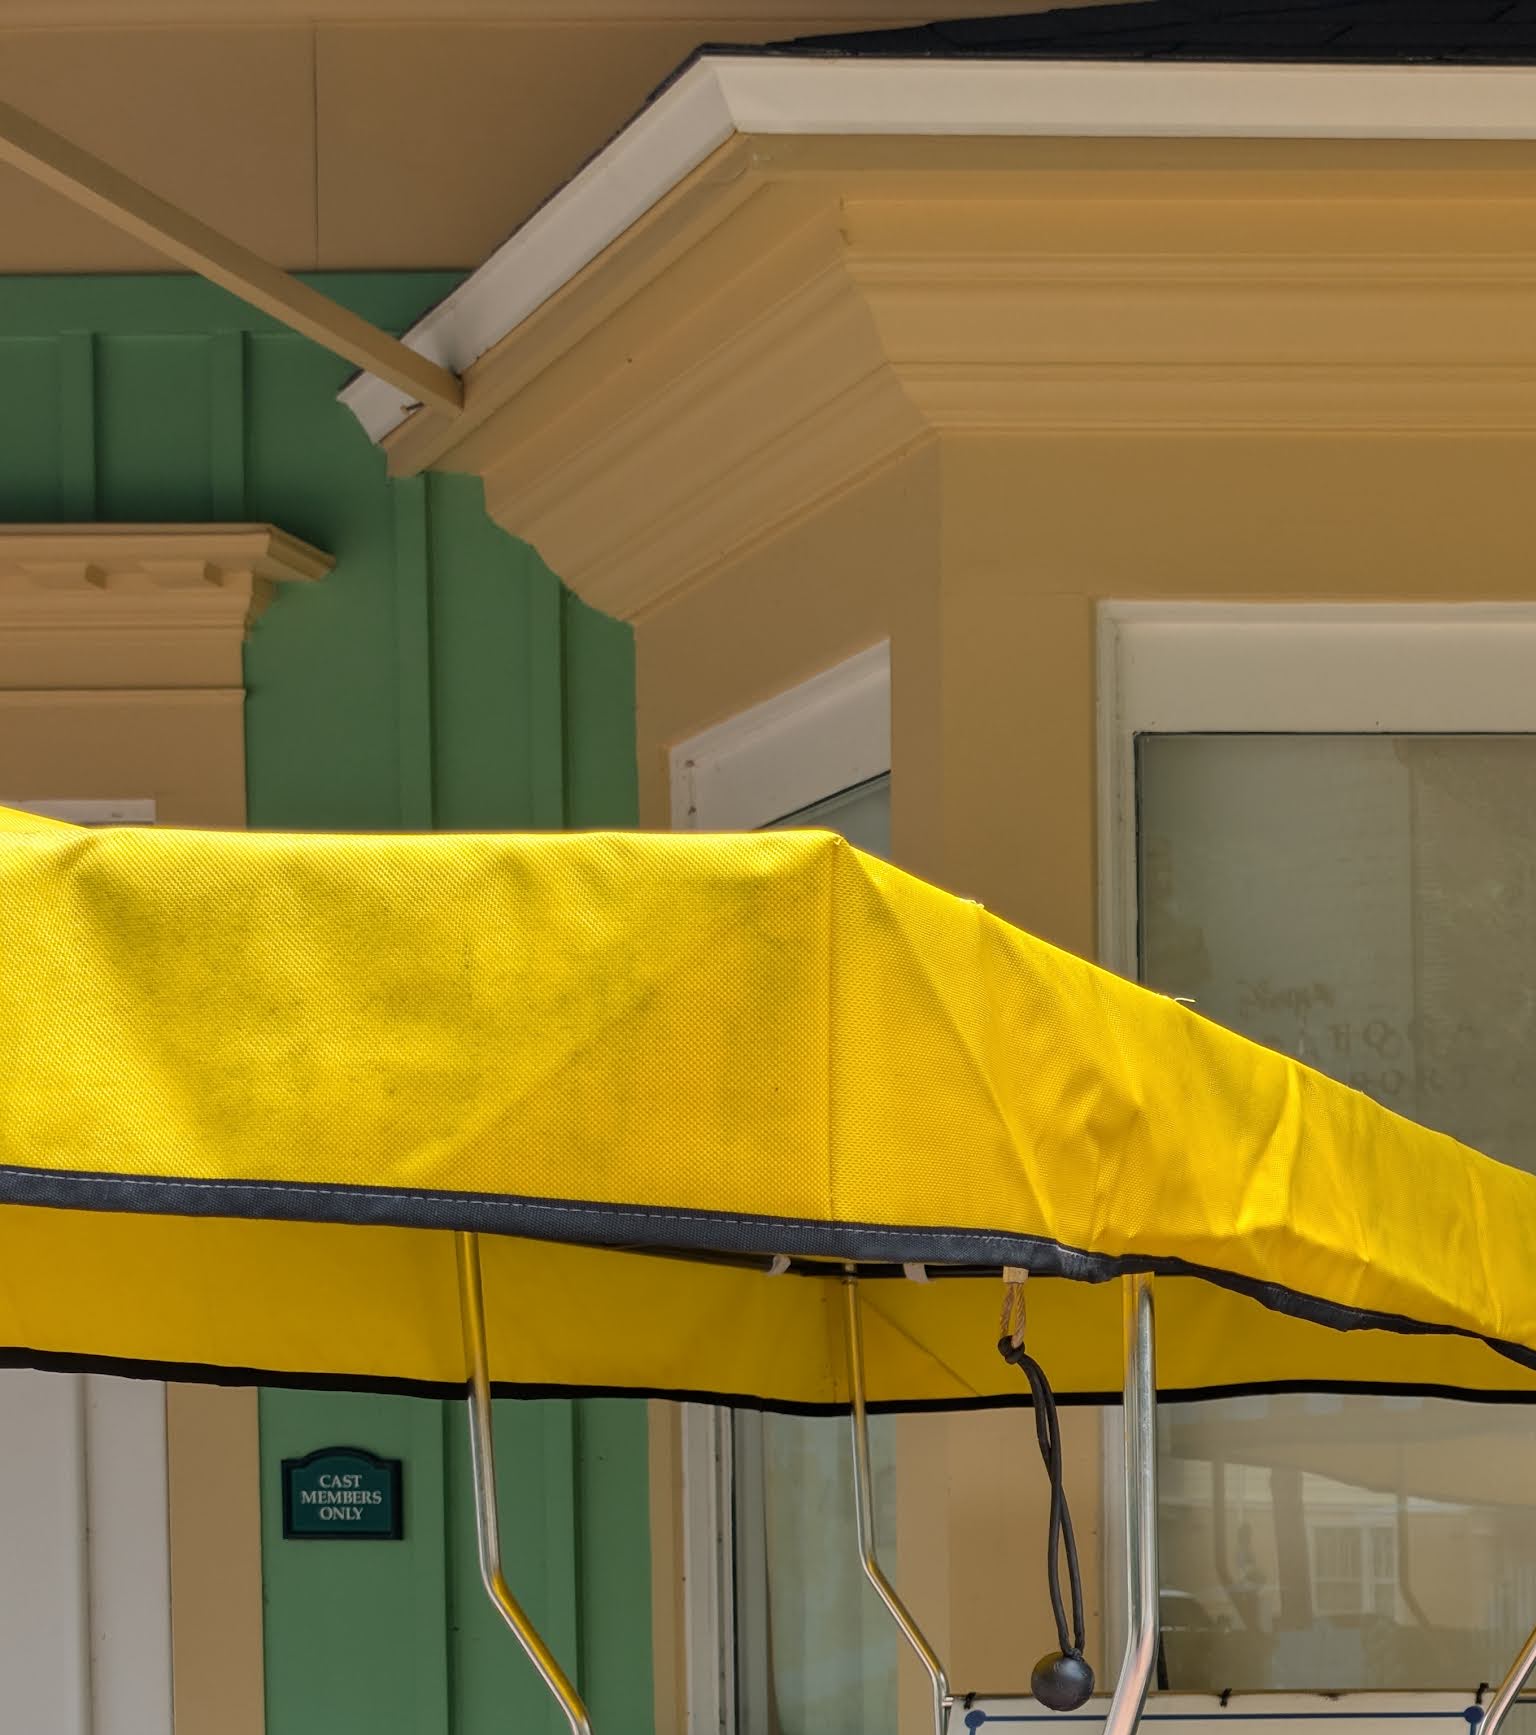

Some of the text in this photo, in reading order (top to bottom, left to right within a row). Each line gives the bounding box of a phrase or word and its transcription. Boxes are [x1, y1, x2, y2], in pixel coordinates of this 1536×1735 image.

[319, 1474, 362, 1489] CAST
[301, 1490, 382, 1504] MEMBERS
[319, 1507, 363, 1520] ONLY
